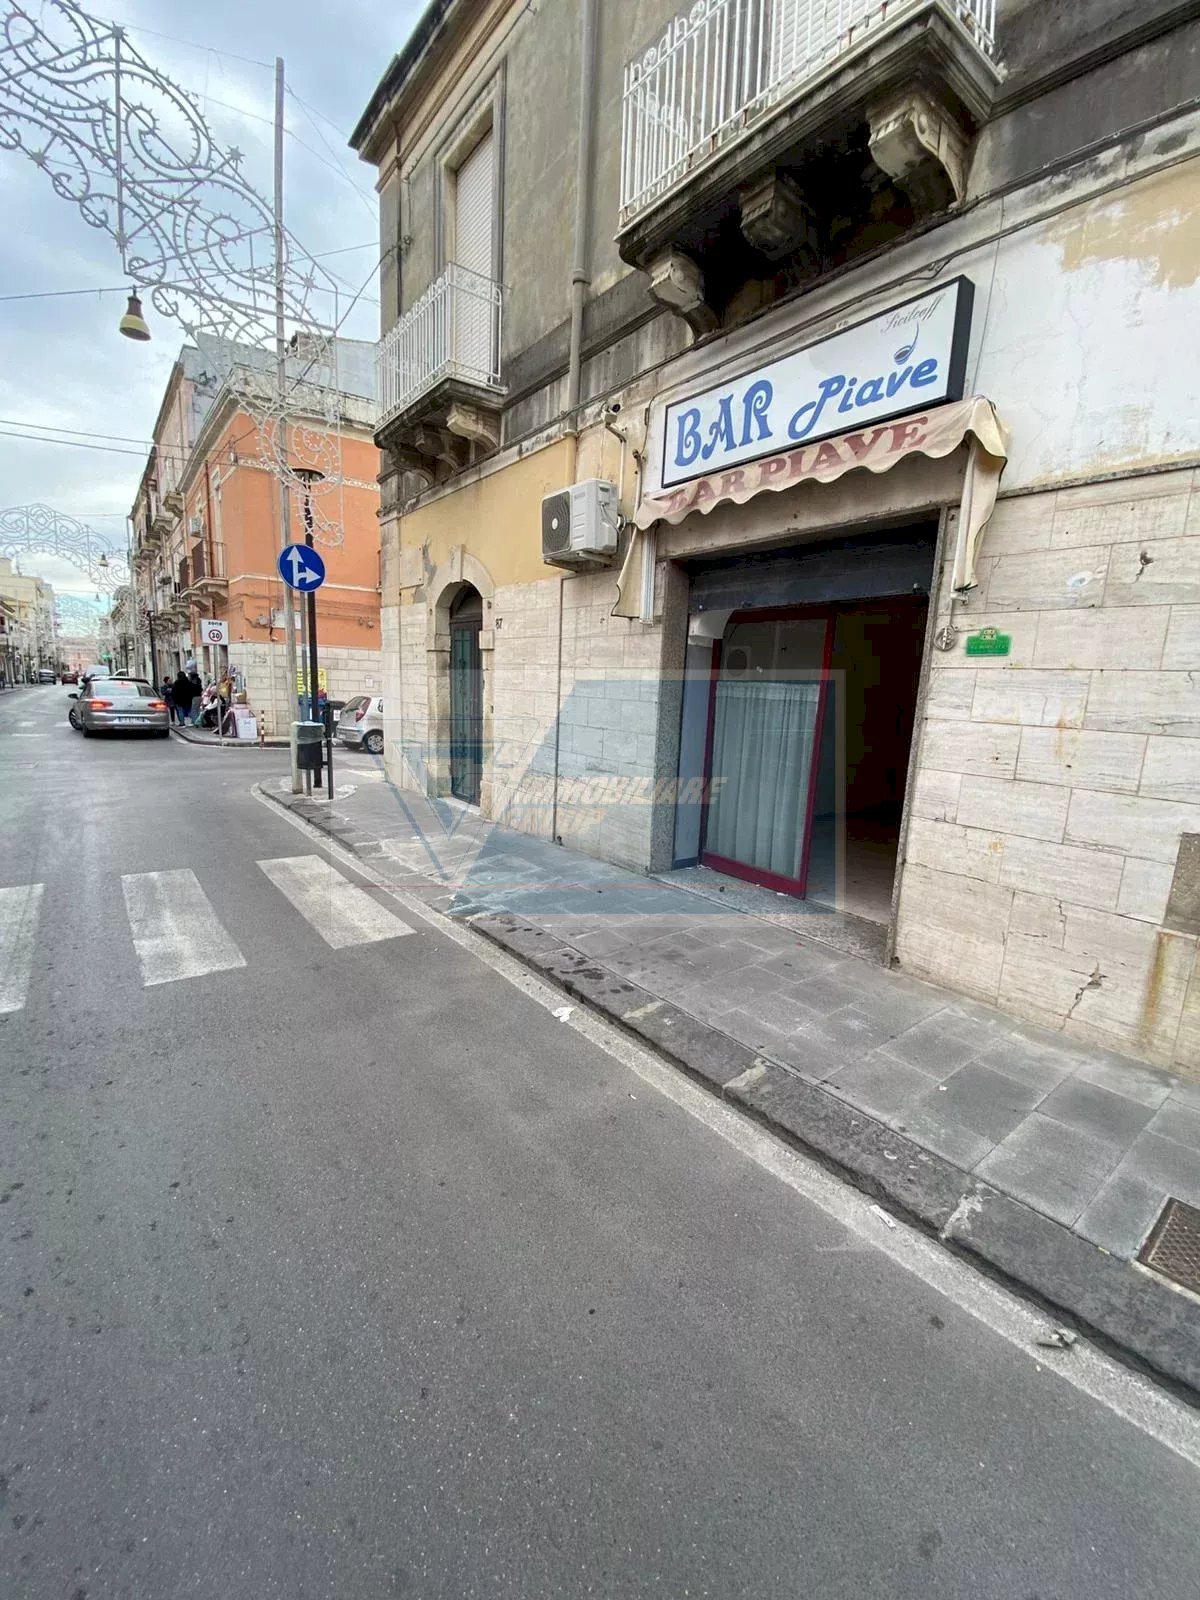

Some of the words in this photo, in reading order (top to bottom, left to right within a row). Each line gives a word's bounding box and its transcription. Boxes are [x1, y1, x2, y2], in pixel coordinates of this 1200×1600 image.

[675, 379, 774, 467] BAR
[788, 357, 938, 440] Piave
[757, 416, 929, 482] PIAVE
